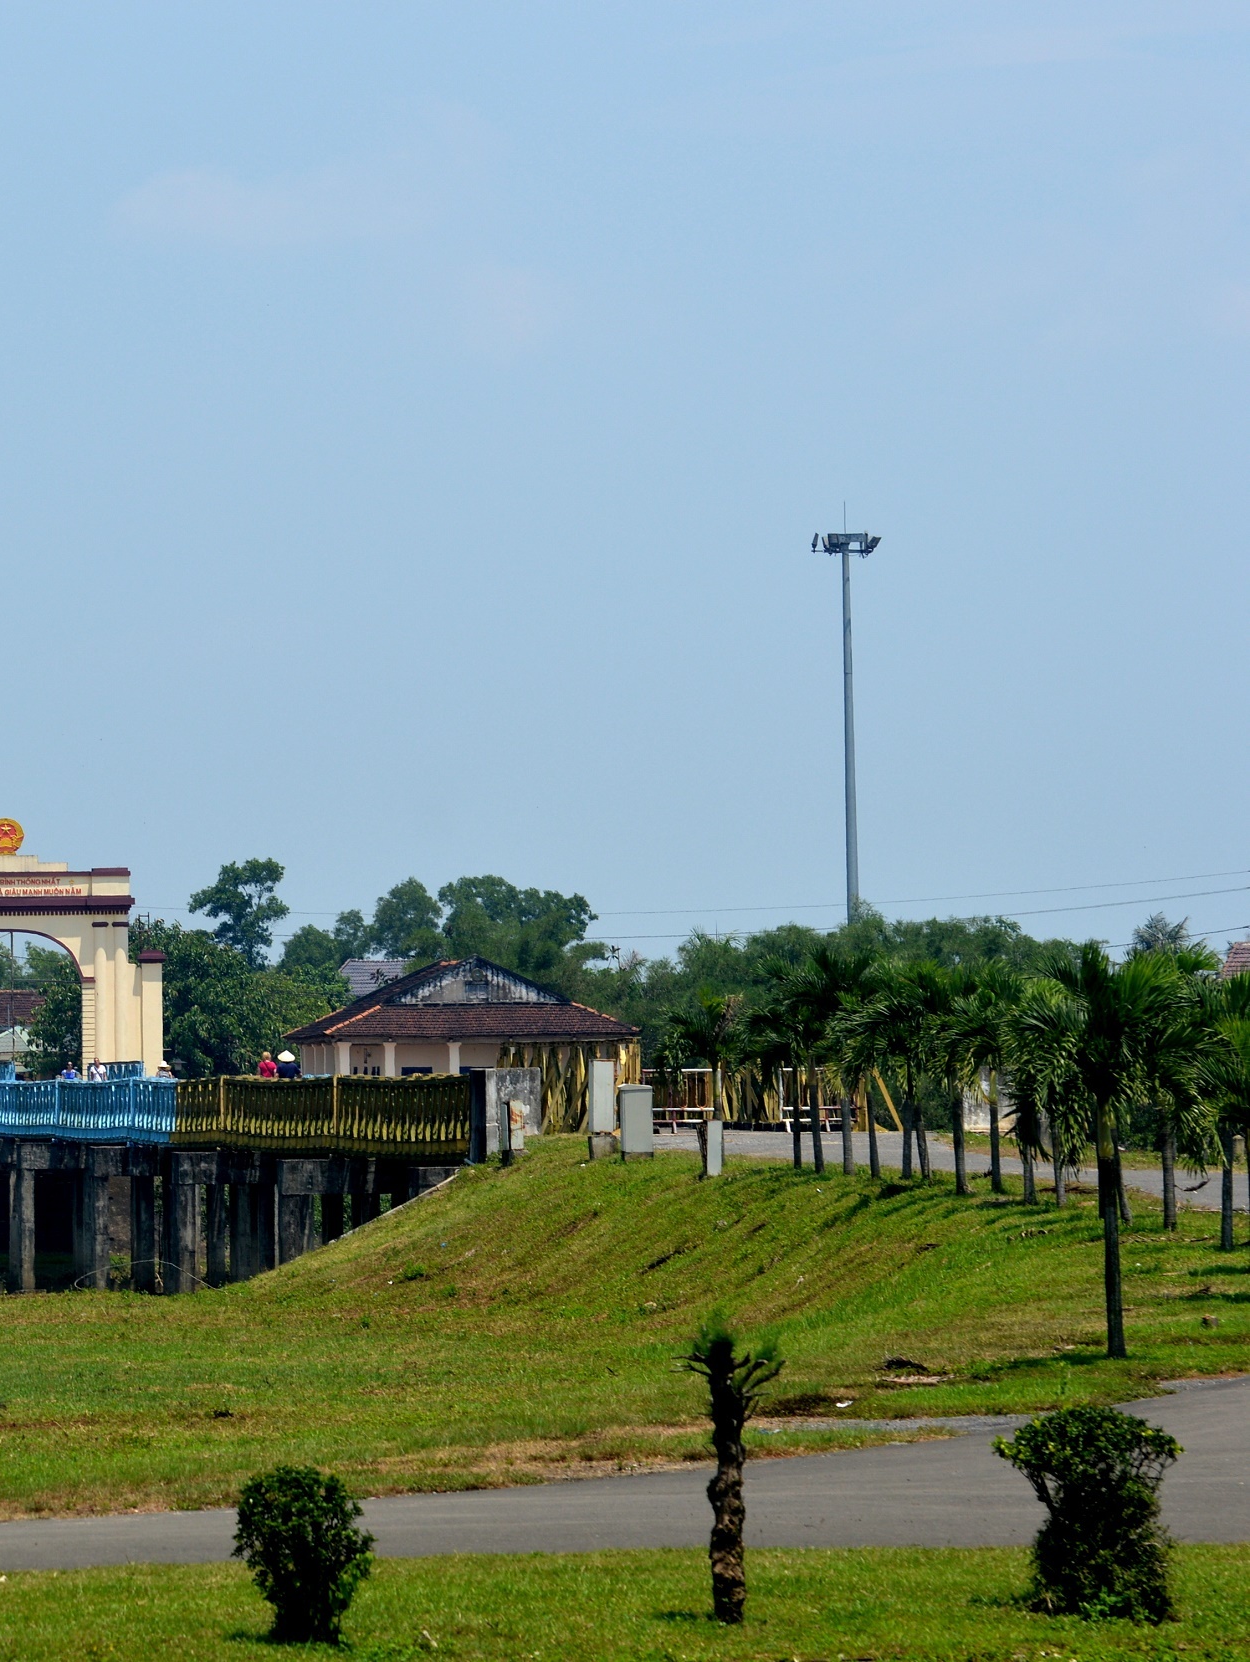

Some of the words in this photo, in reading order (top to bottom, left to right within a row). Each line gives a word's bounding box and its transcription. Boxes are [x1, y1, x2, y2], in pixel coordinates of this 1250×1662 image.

[0, 877, 15, 885] BÌNH
[16, 876, 40, 885] THỐNG
[41, 875, 60, 885] NHẤT
[43, 887, 63, 896] MUÔN
